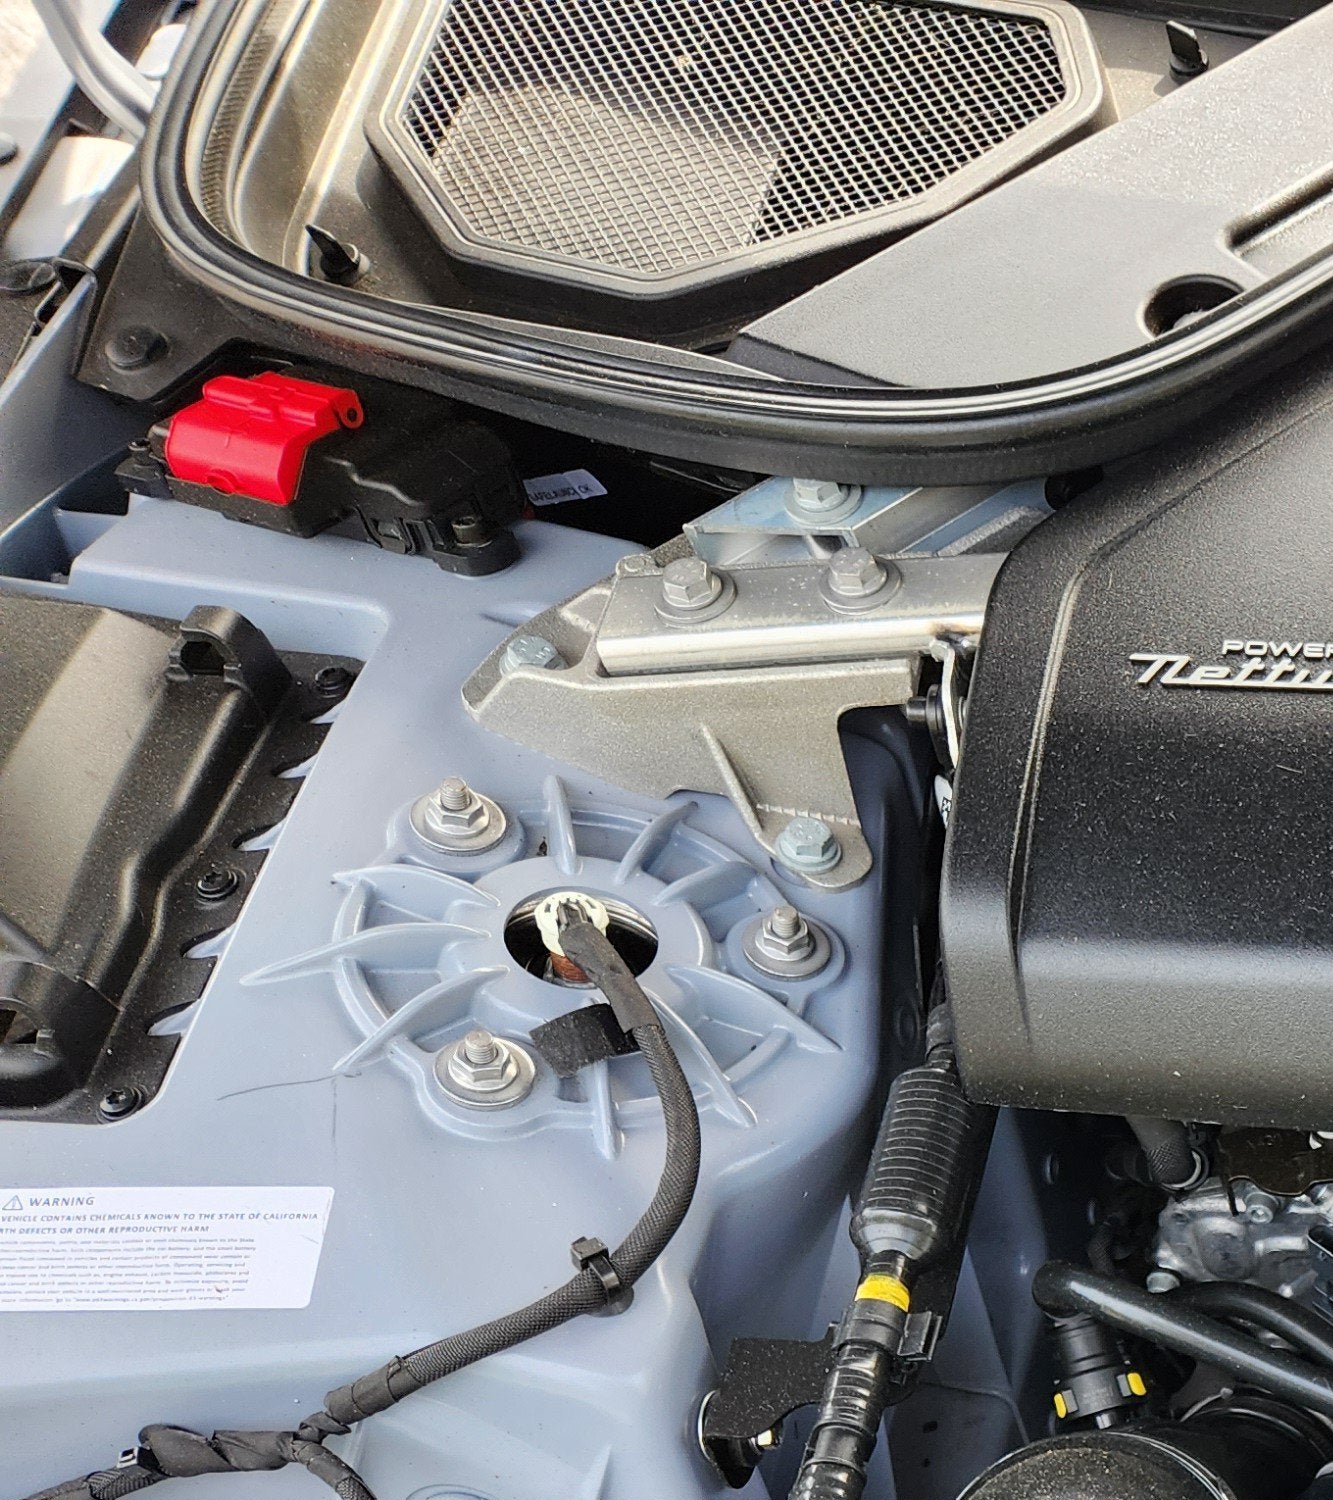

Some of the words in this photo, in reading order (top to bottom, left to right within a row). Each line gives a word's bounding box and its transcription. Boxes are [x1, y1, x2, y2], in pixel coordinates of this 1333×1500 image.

[29, 1196, 95, 1206] WARNING
[1, 1214, 38, 1222] VEHICLE
[40, 1214, 87, 1222] CONTAINS
[89, 1213, 142, 1222] CHEMICALS
[143, 1213, 180, 1221] KNOWN
[182, 1212, 195, 1220] TO
[199, 1212, 215, 1220] THE
[217, 1212, 246, 1220] STATE
[248, 1212, 260, 1220] OF
[263, 1212, 318, 1220] CALIFORNIA
[60, 1226, 73, 1234] OR
[75, 1226, 106, 1234] OTHER
[108, 1225, 178, 1233] REPRODUCTIVE
